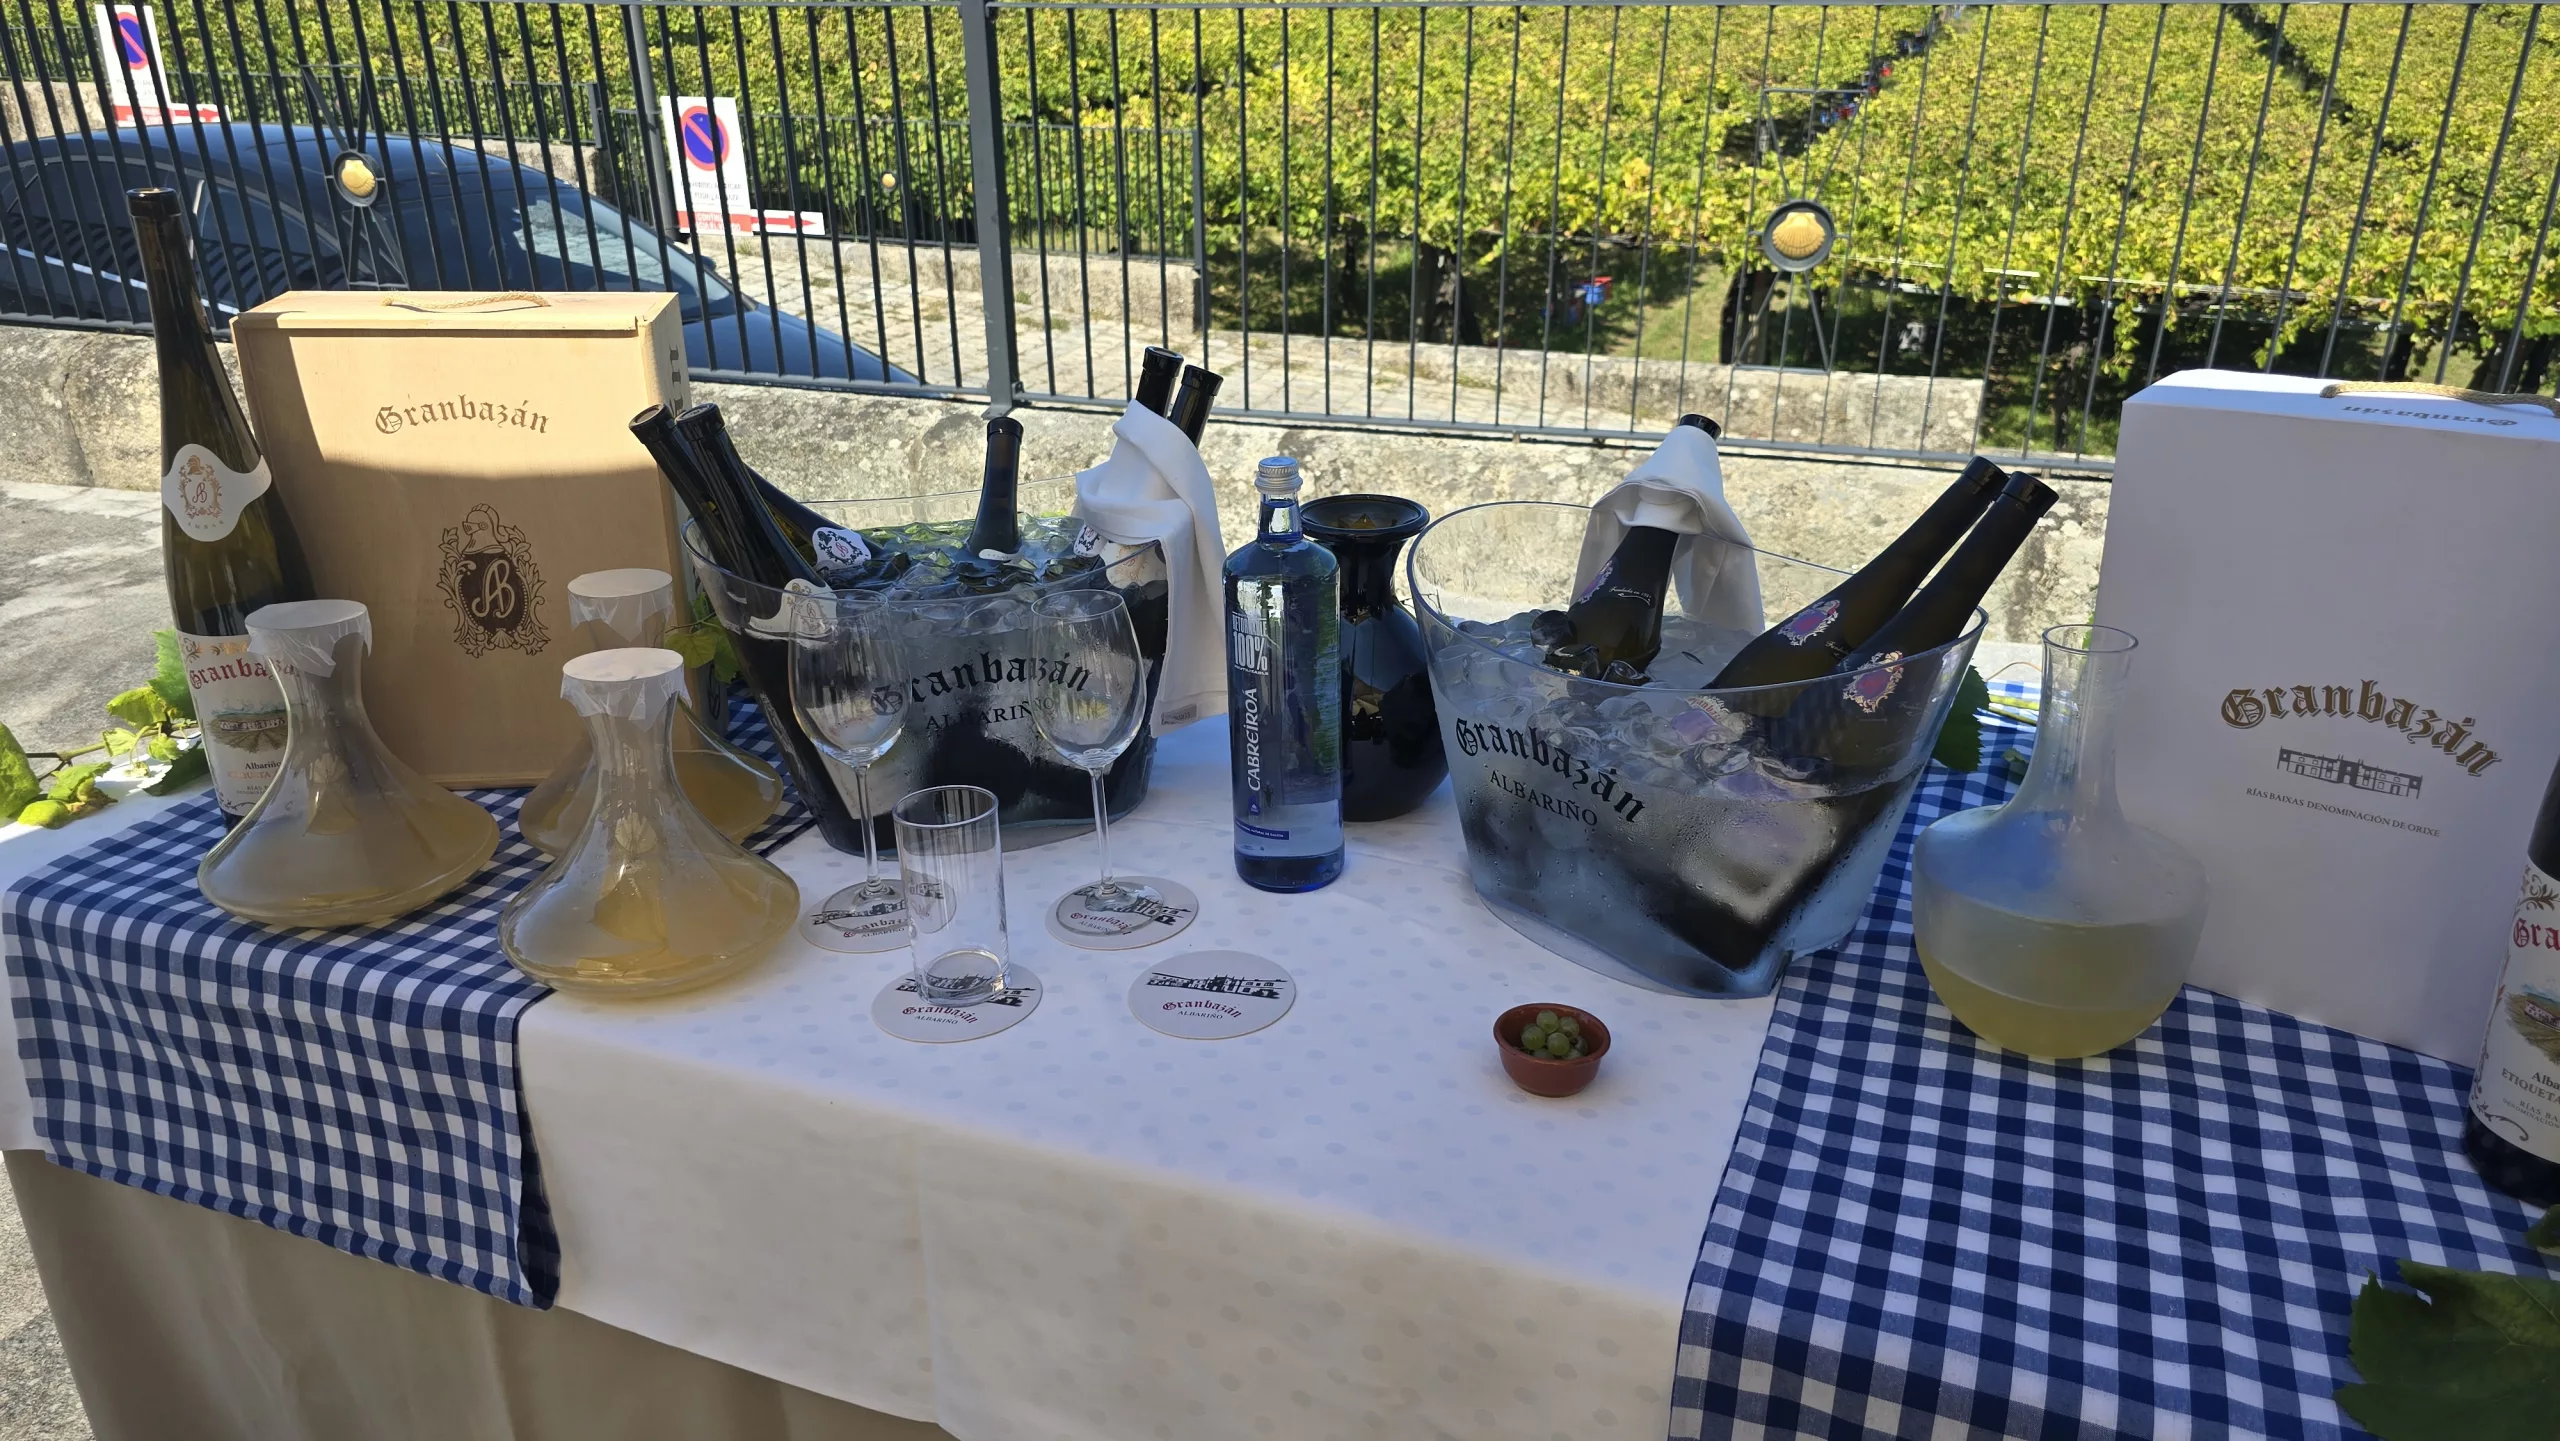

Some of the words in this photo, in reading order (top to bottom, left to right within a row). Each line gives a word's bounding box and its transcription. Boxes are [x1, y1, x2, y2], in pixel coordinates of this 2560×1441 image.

[375, 394, 550, 435] Granbazán
[1233, 630, 1268, 671] 100%
[870, 651, 1094, 716] Granbazán
[2221, 679, 2503, 778] Granbazán
[1455, 717, 1647, 824] Granbazán
[1489, 769, 1599, 827] ALBARIÑO
[2246, 787, 2269, 800] RÍAS
[2269, 792, 2305, 807] BAIXAS
[2306, 799, 2392, 827] DENOMINACIÓN
[2391, 819, 2407, 830] DE
[2407, 823, 2441, 838] ORIXE
[902, 1005, 978, 1025] Granbazán
[1162, 999, 1242, 1019] Granbazán
[1177, 1009, 1224, 1020] ALBARIÑO
